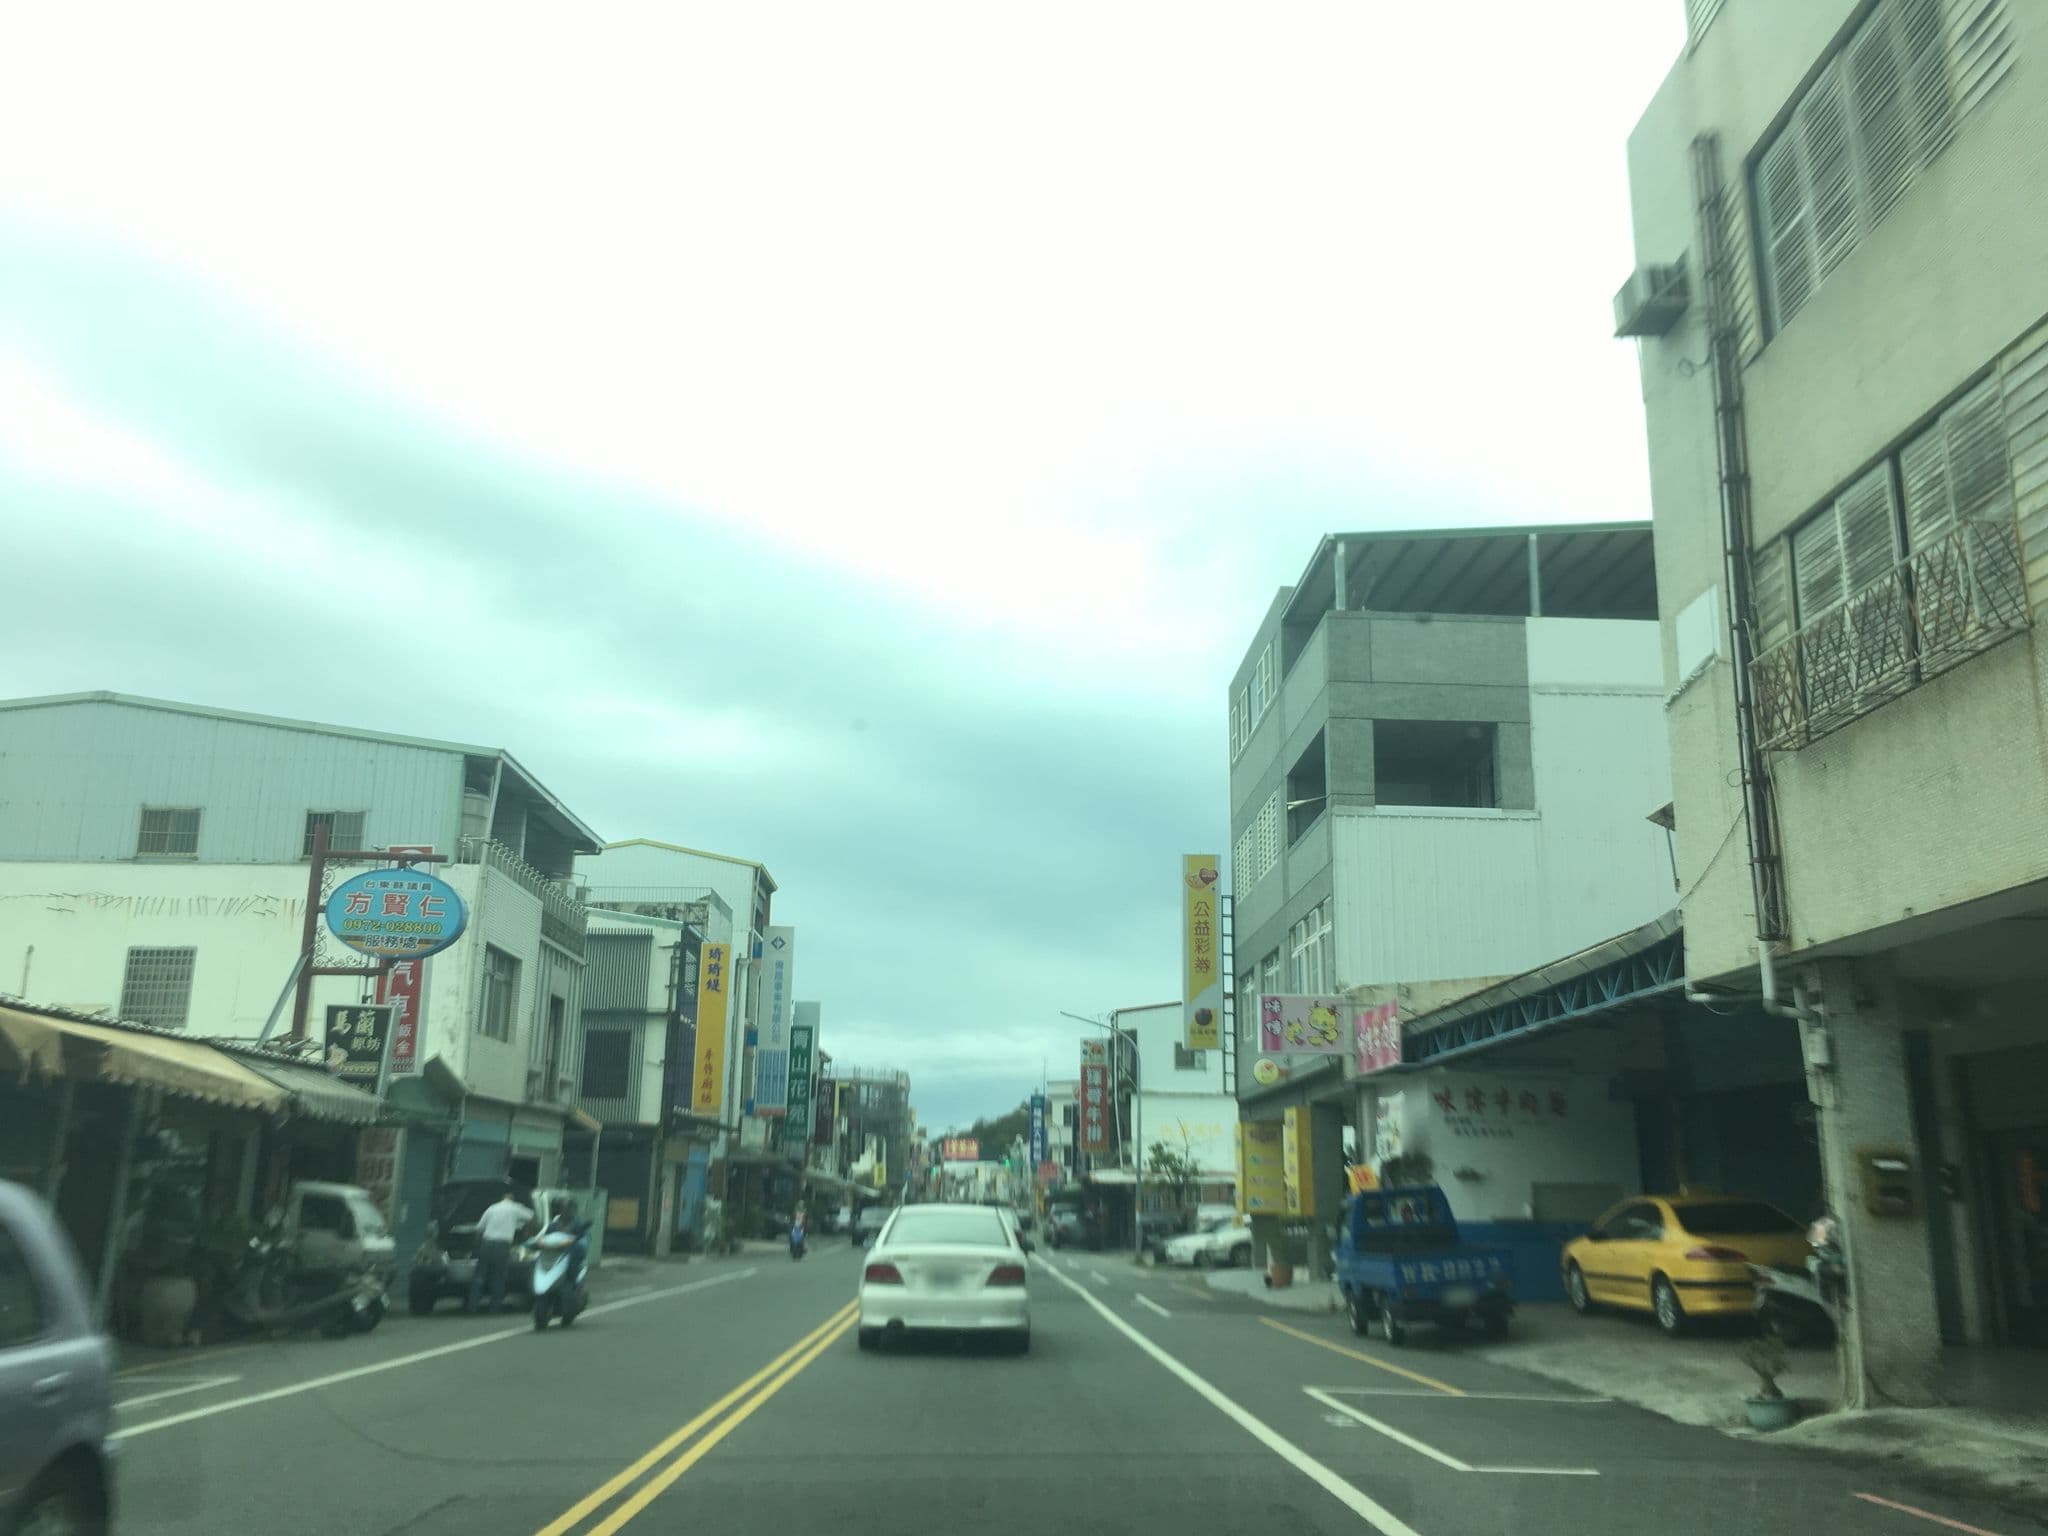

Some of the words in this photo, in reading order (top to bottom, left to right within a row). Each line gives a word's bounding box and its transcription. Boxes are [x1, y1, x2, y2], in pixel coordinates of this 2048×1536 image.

[345, 891, 446, 918] 方賢仁
[364, 934, 420, 950] 服務處
[1193, 901, 1211, 974] 公益彩券
